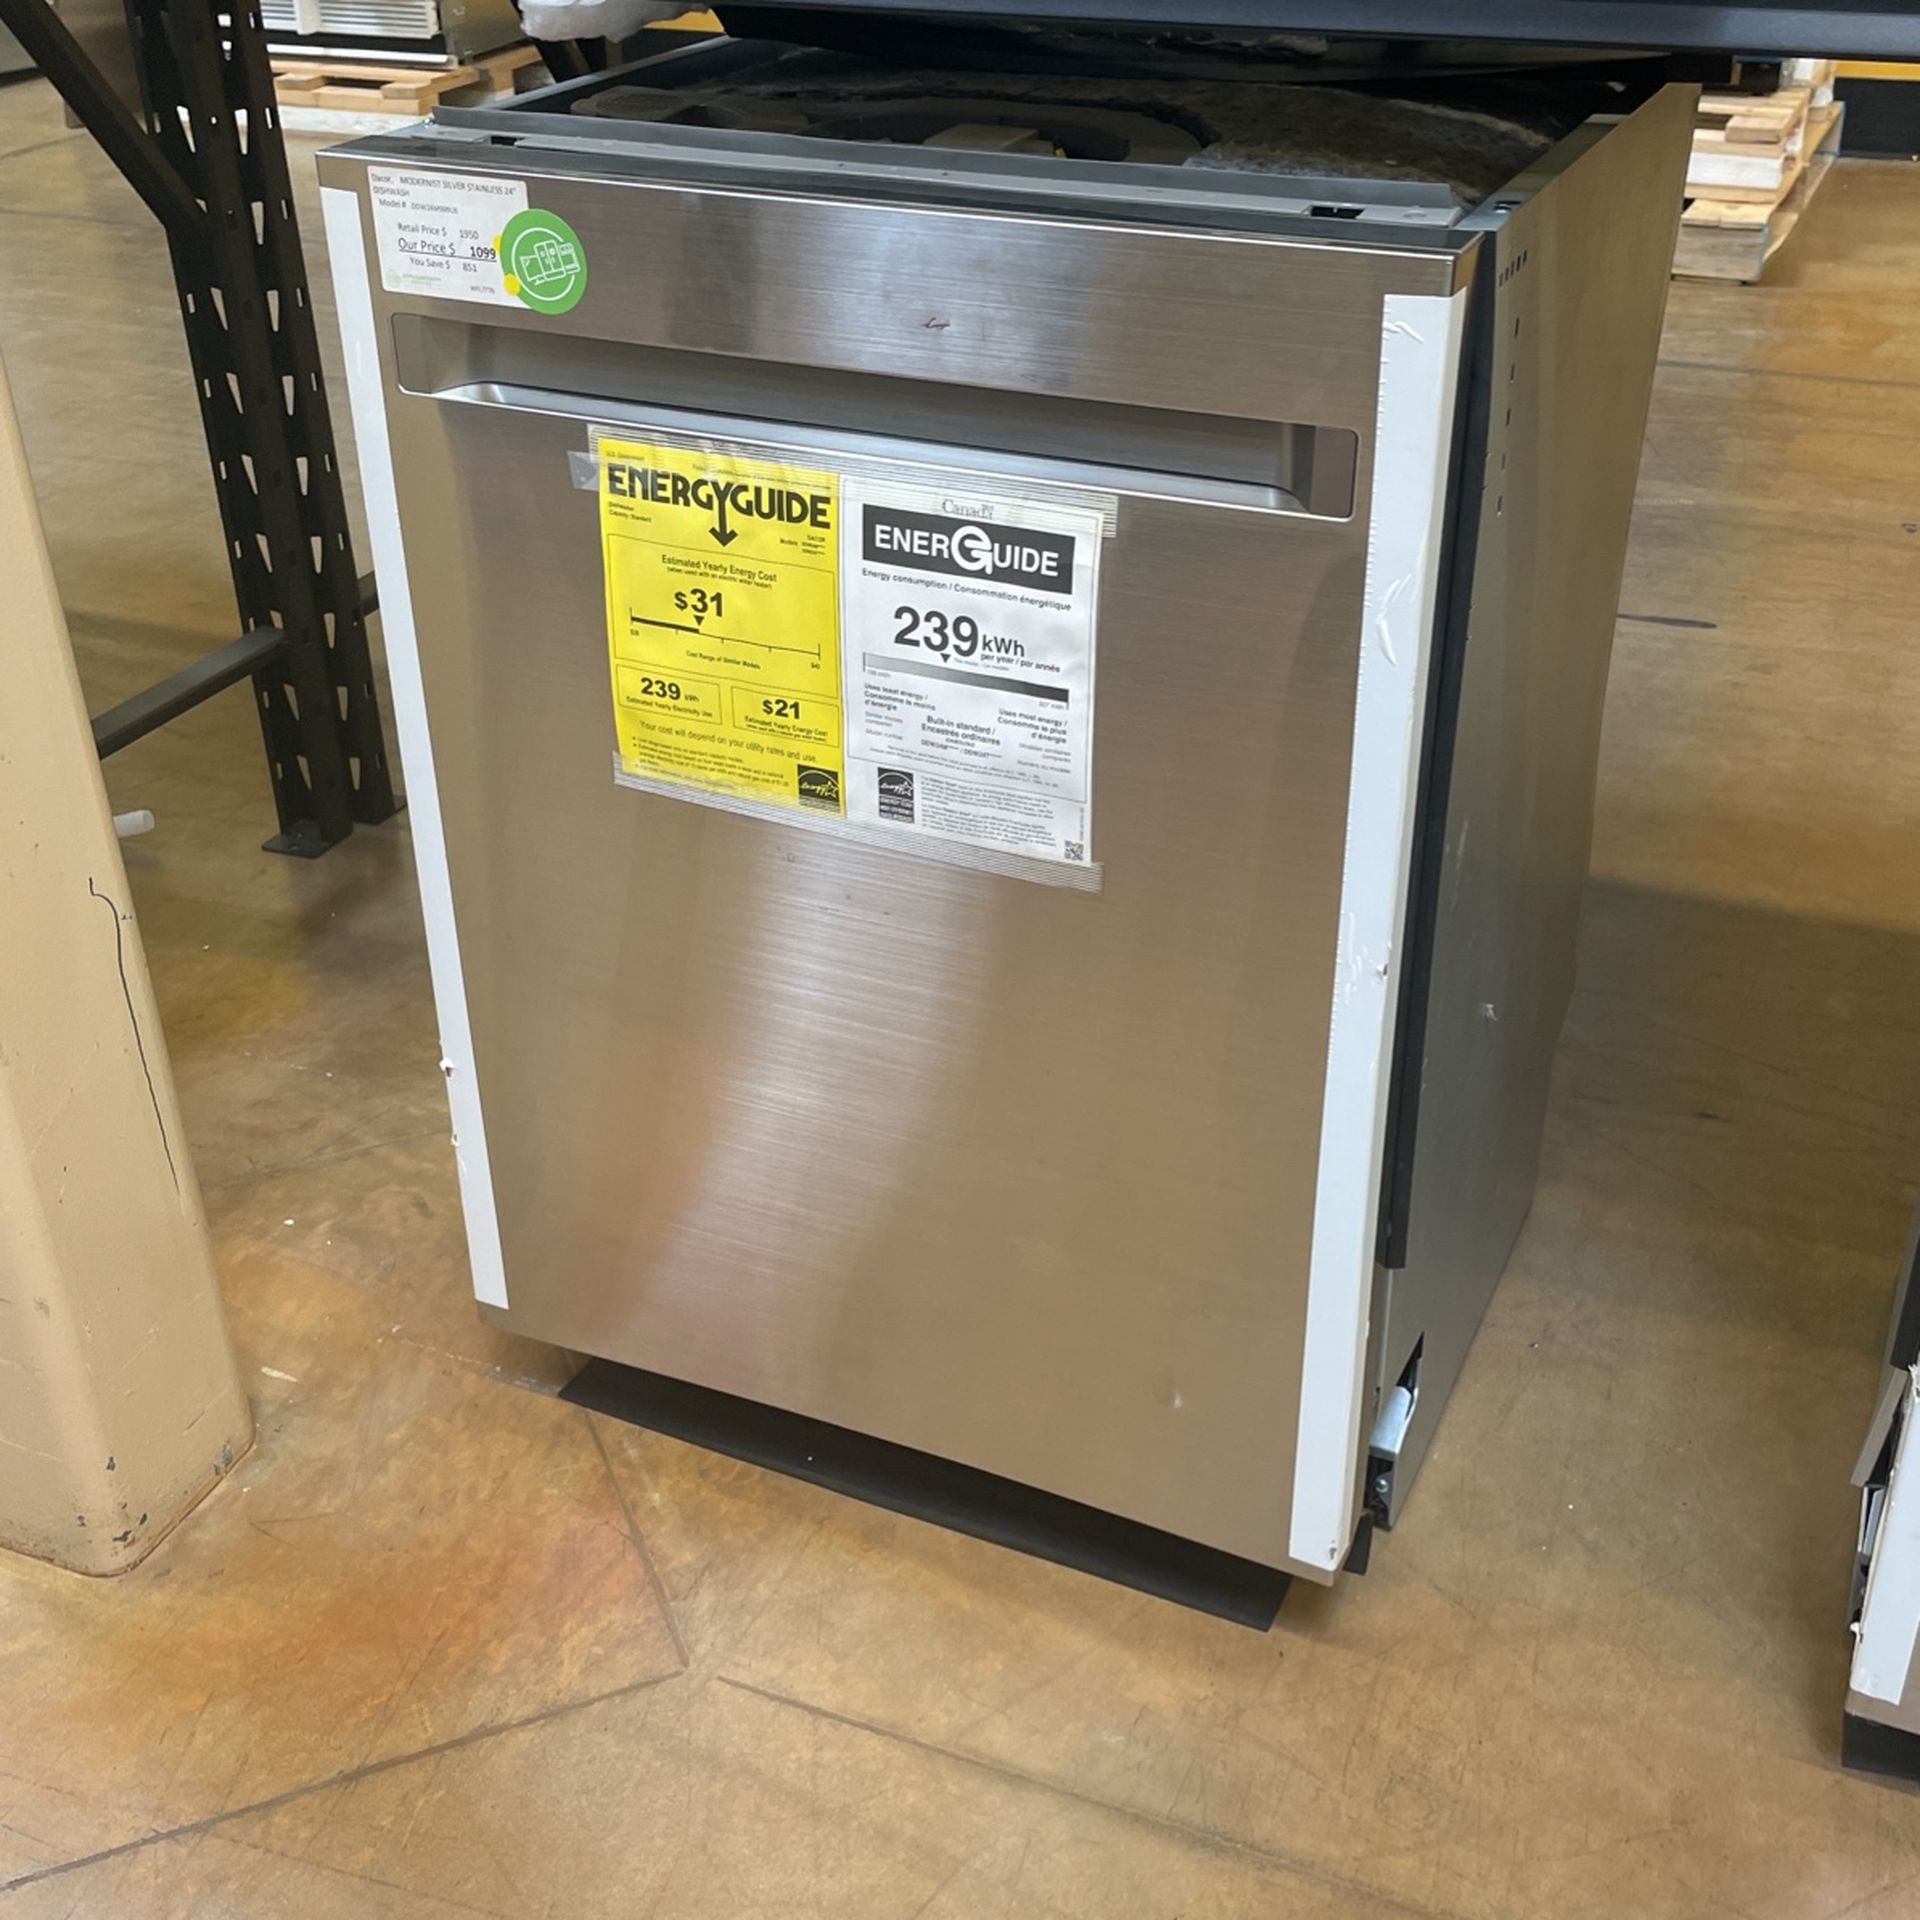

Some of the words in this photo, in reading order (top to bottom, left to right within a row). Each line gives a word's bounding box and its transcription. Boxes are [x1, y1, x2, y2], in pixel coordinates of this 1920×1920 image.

[400, 176, 440, 188] MODERNIST
[442, 181, 465, 190] SILVER
[466, 183, 502, 195] STAINLESS
[379, 198, 400, 208] Model
[398, 222, 419, 234] Retail
[420, 225, 440, 236] Price
[441, 227, 447, 237] $
[459, 229, 479, 240] 1950
[398, 237, 417, 251] Our
[420, 239, 446, 255] Price
[450, 242, 456, 257] $
[470, 246, 496, 259] 1099
[410, 257, 425, 267] You
[426, 260, 444, 270] Save
[445, 261, 451, 270] $
[462, 263, 478, 272] 851
[608, 462, 831, 530] ENERGYGUIDE
[874, 524, 1060, 577] ENERGUIDE
[661, 554, 701, 569] Estimated
[702, 561, 728, 574] Yearly
[729, 564, 757, 580] Energy
[758, 570, 777, 582] Cost
[862, 568, 890, 582] Energy
[893, 574, 947, 590] consumption
[954, 583, 1018, 601] Consommation
[1019, 593, 1072, 612] énergétique
[674, 588, 724, 618] $31
[893, 605, 980, 657] 239
[982, 634, 1025, 658] kWh
[686, 650, 699, 658] Cost
[700, 653, 716, 662] Range
[723, 656, 741, 665] Similar
[742, 660, 761, 669] Models
[981, 653, 995, 662] per
[996, 656, 1014, 664] year
[1020, 659, 1034, 668] par
[1035, 662, 1060, 672] année
[641, 677, 681, 701] 239
[864, 682, 881, 691] Uses
[882, 686, 899, 694] least
[900, 690, 924, 701] energy
[626, 695, 654, 707] Estimated
[654, 701, 671, 711] Yearly
[672, 704, 701, 717] Electricity
[701, 710, 714, 718] Use
[762, 698, 800, 720] $21
[864, 690, 904, 704] Consomme
[913, 702, 936, 711] moins
[864, 699, 898, 711] d'énergie
[744, 715, 772, 727] Estimated
[773, 721, 791, 731] Yearly
[792, 724, 813, 736] Energy
[814, 728, 829, 737] Cost
[926, 715, 954, 727] Built-in
[956, 722, 991, 735] standard
[997, 716, 1039, 730] Consomme
[1050, 727, 1067, 735] plus
[999, 707, 1017, 717] Uses
[1018, 713, 1036, 721] most
[1038, 717, 1062, 727] energy
[640, 719, 656, 732] Your
[658, 724, 673, 735] cost
[674, 726, 687, 737] will
[688, 729, 716, 744] depend
[717, 734, 727, 743] on
[728, 737, 744, 749] your
[746, 739, 765, 754] utility
[766, 745, 785, 757] rates
[786, 749, 801, 760] and
[921, 723, 960, 738] Encastrés
[961, 732, 1001, 746] ordinaires
[1031, 732, 1067, 744] d'énergie
